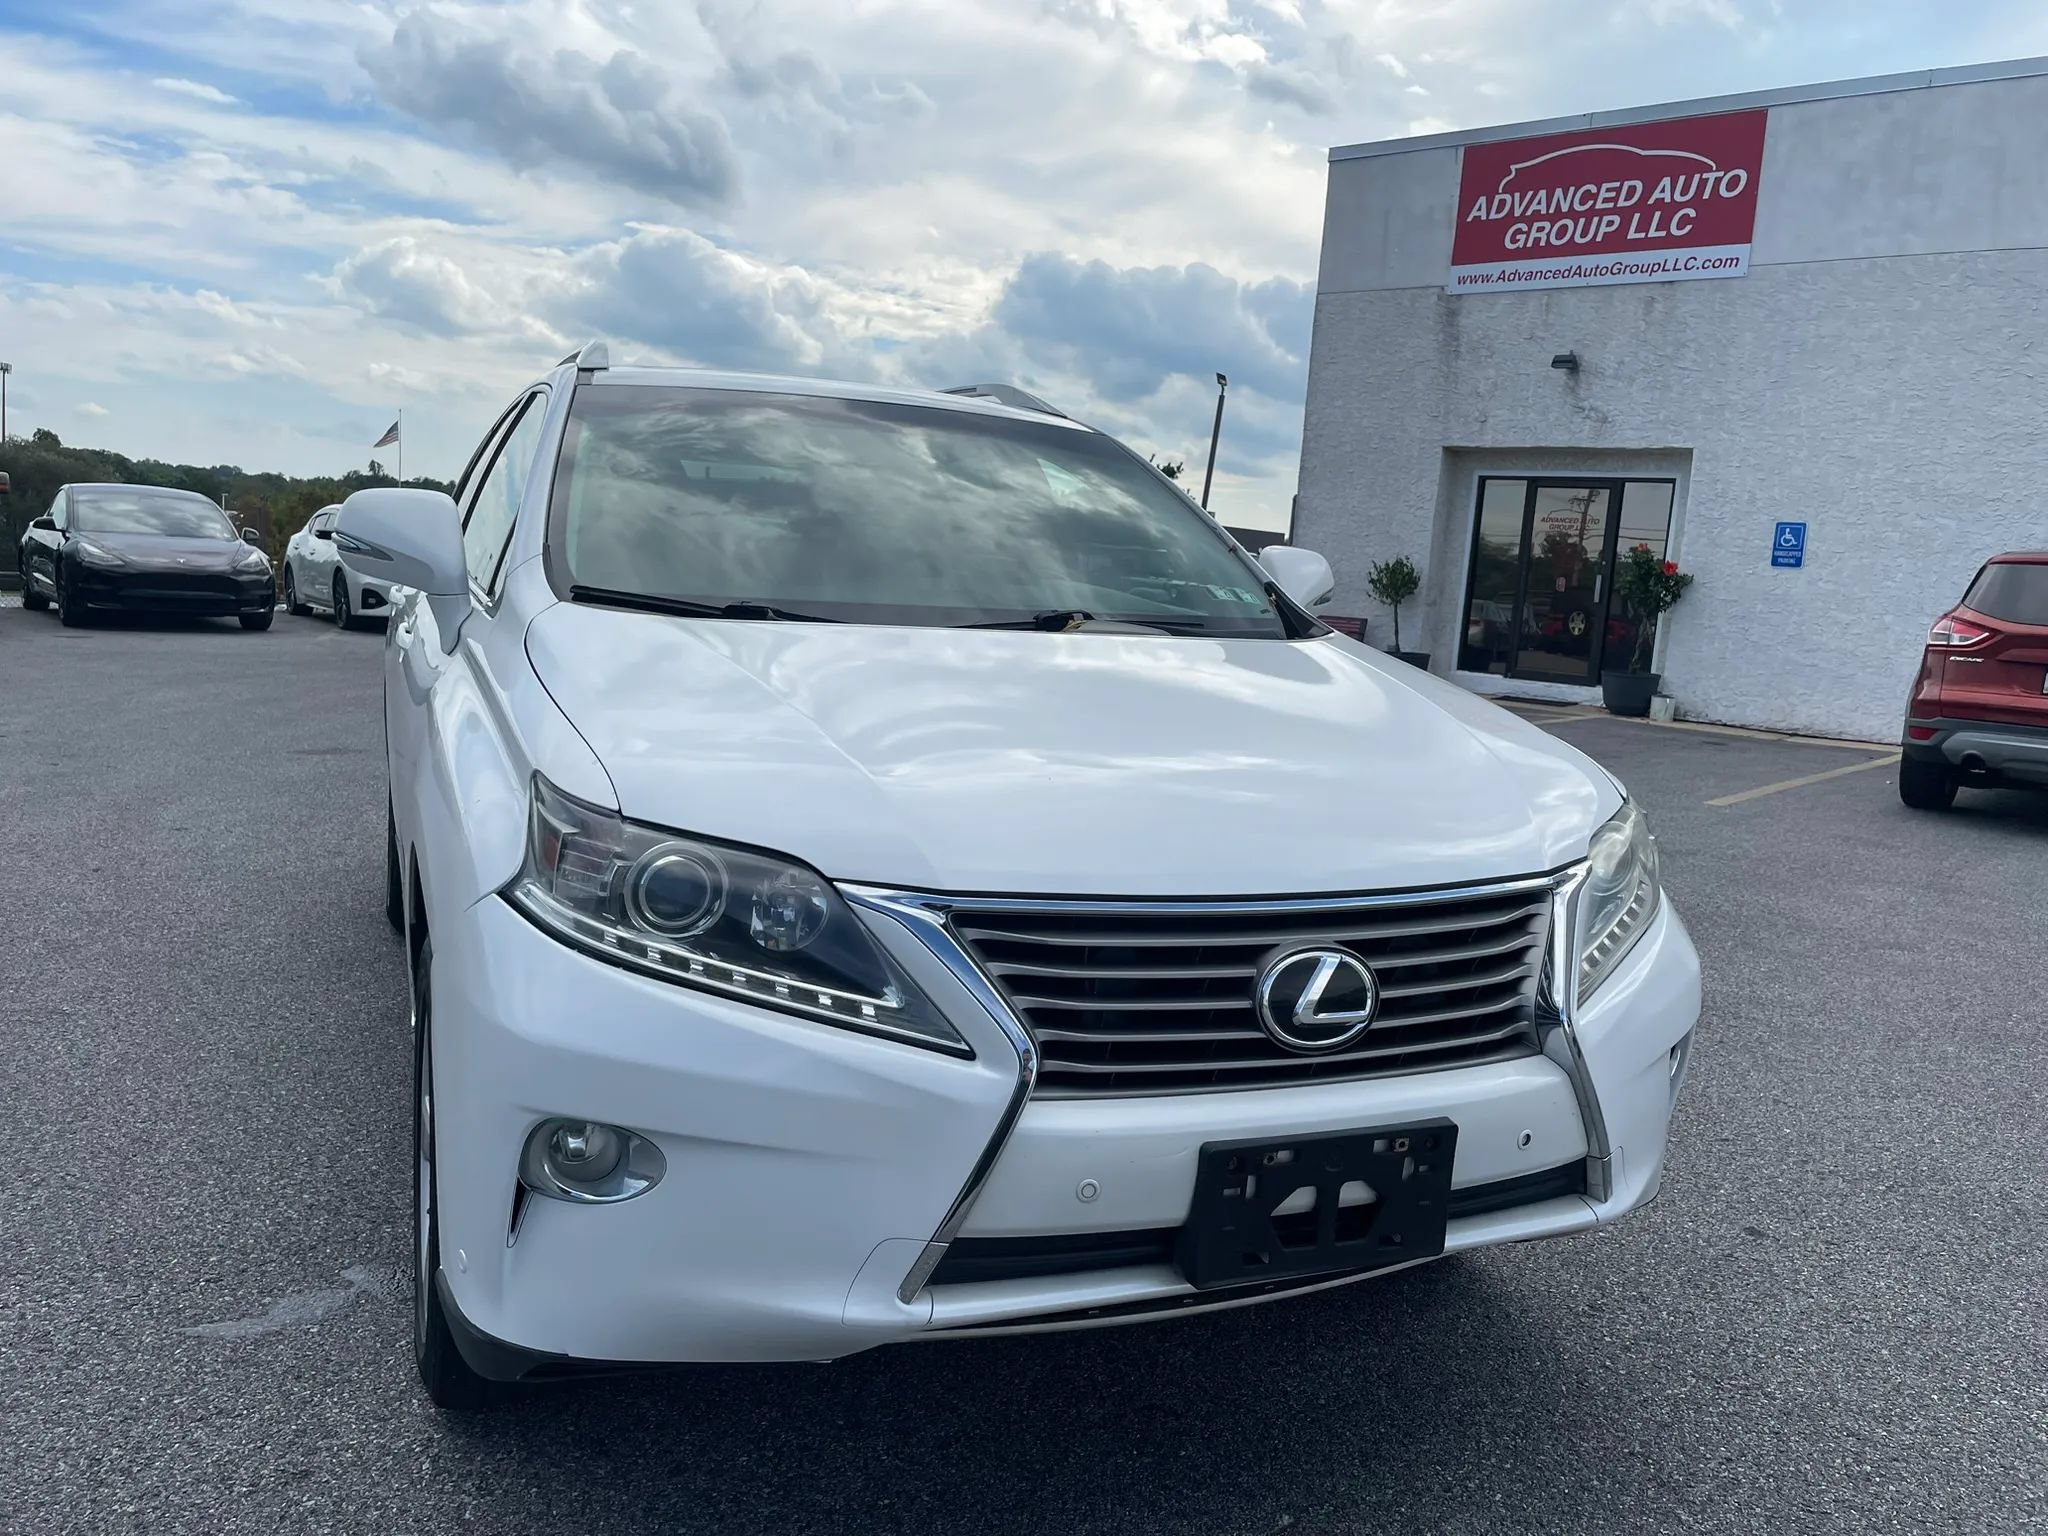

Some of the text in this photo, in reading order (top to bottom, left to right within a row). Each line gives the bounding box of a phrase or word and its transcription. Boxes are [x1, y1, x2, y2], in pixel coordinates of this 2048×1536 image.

[1467, 169, 1748, 222] ADVANCED AUTO
[1504, 208, 1697, 250] GROUP LLC
[1457, 256, 1740, 286] www.AdvancedAutoGroupLLC.com
